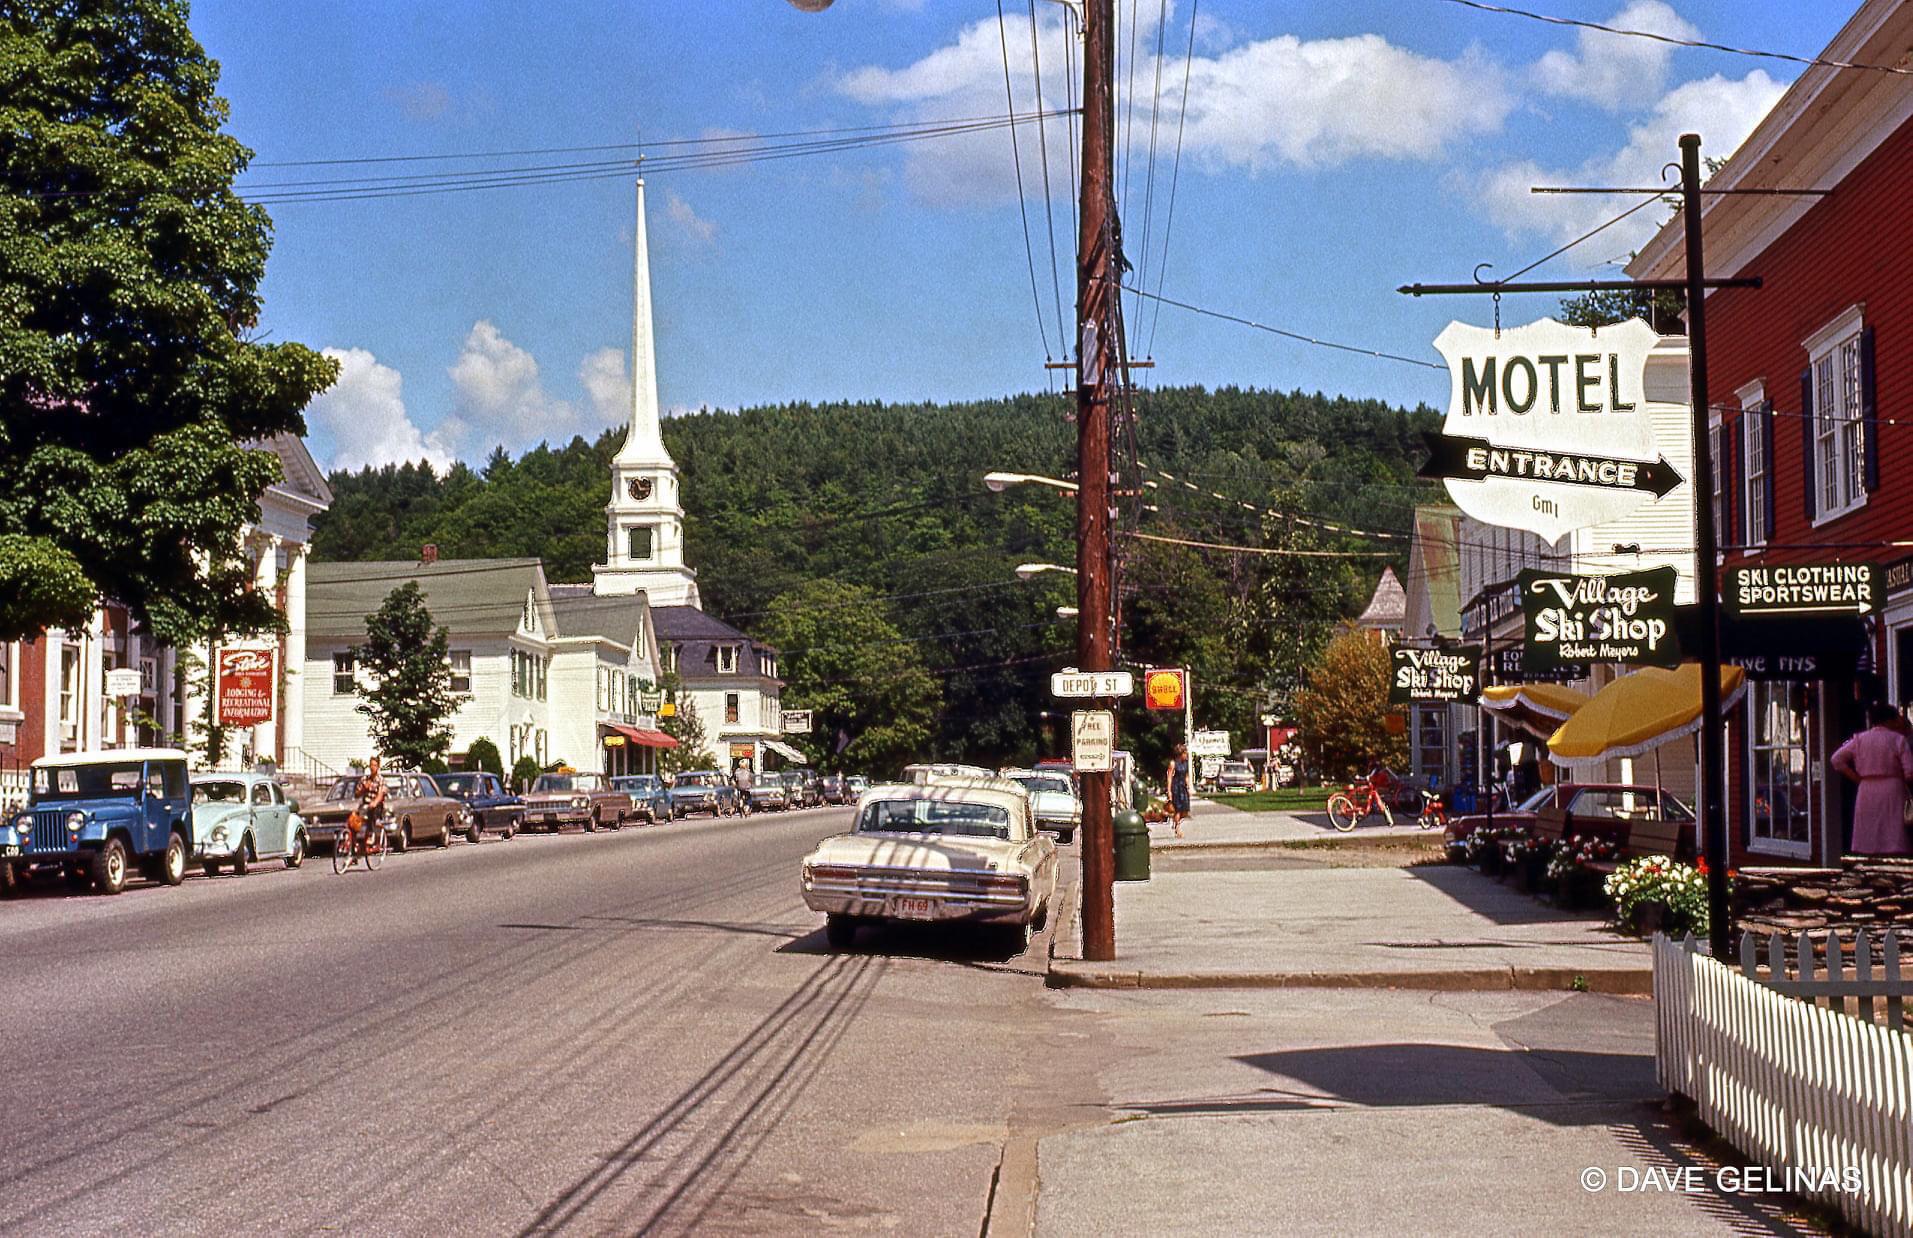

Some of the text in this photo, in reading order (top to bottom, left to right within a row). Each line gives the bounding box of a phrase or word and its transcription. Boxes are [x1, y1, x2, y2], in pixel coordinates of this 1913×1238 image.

[1461, 353, 1636, 416] MOTEL
[1466, 447, 1639, 487] ENTRANCE
[1738, 565, 1871, 586] SKI CLOTHING
[1531, 578, 1659, 616] Village
[1738, 583, 1871, 604] SPORTSWEAR
[1534, 607, 1584, 642] Ski
[1588, 605, 1667, 651] Shop
[1395, 649, 1471, 674] Village
[1559, 642, 1598, 659] Robert
[1062, 678, 1117, 693] DEPOT ST
[1396, 666, 1474, 695] Ski Shop
[221, 698, 271, 707] RECREATIONAL
[223, 707, 268, 718] INFORMATION
